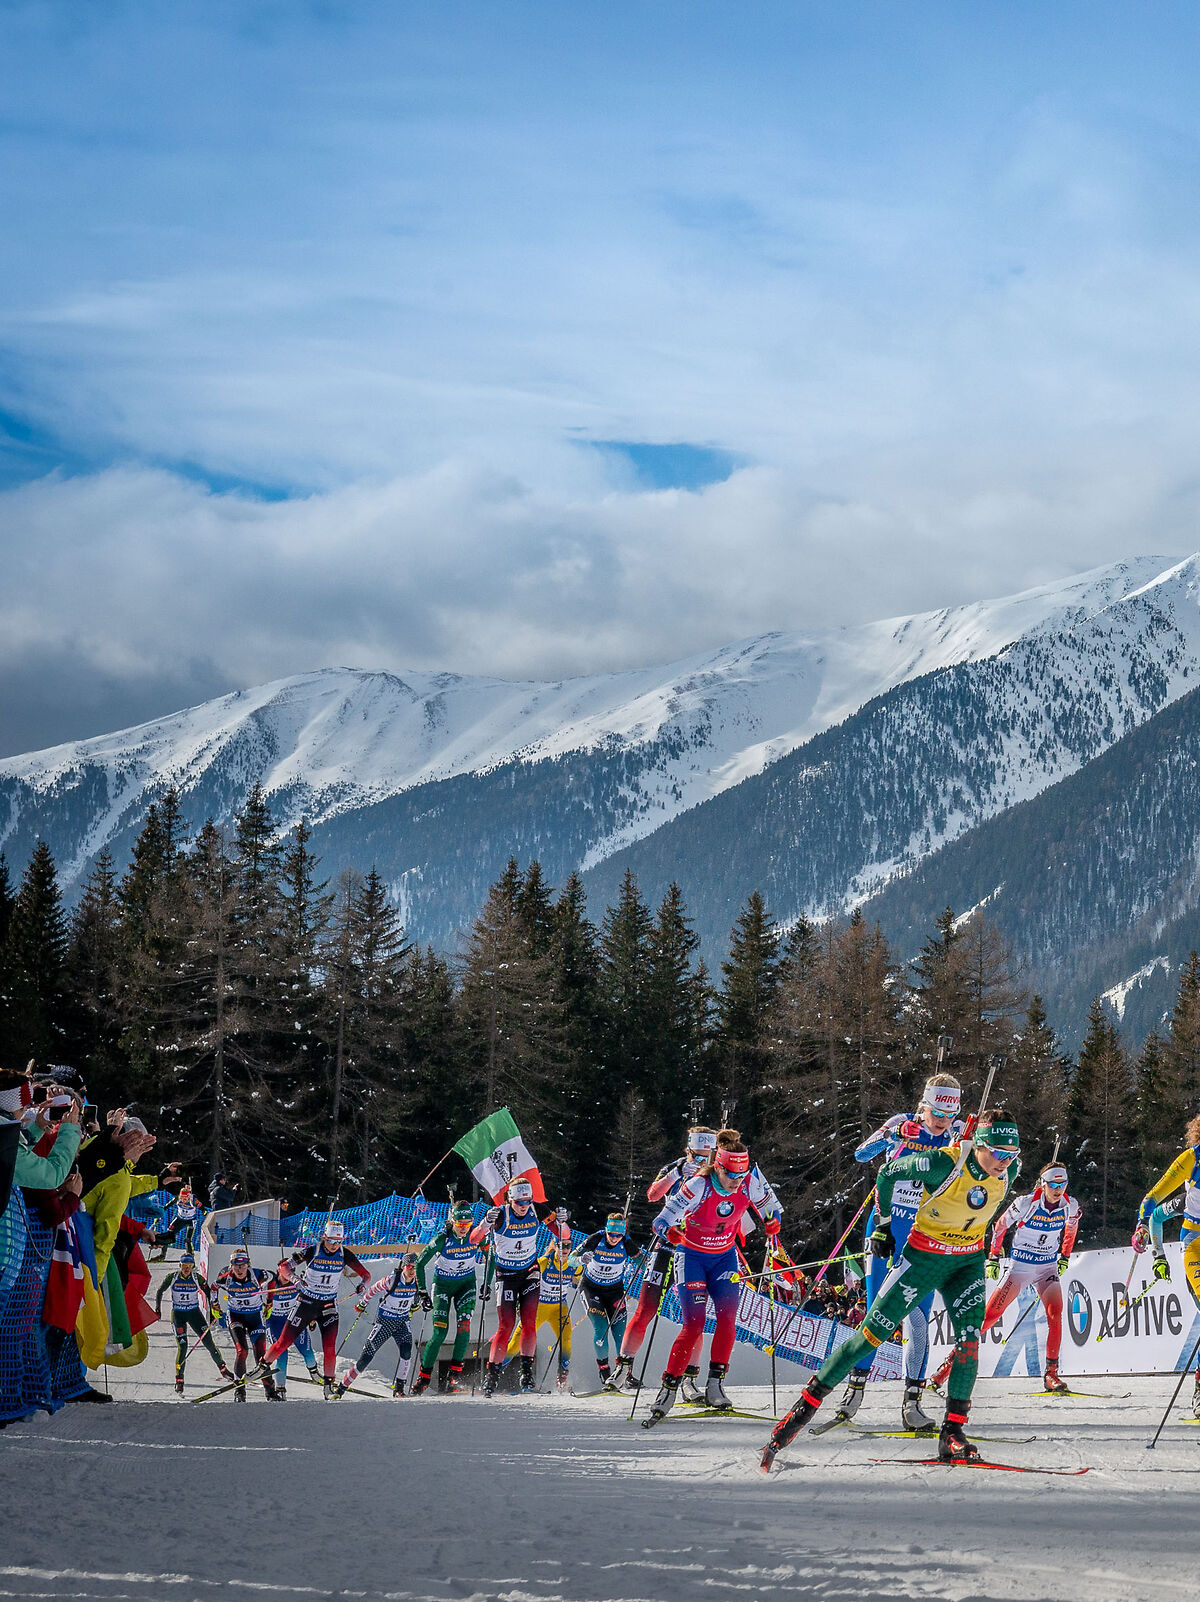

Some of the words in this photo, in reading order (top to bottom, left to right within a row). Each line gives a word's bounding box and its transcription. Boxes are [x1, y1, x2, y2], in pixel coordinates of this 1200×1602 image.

[515, 1240, 522, 1251] 4
[457, 1261, 465, 1269] 2
[320, 1275, 331, 1285] 11
[180, 1293, 190, 1301] 21
[1097, 1280, 1183, 1338] xDrive
